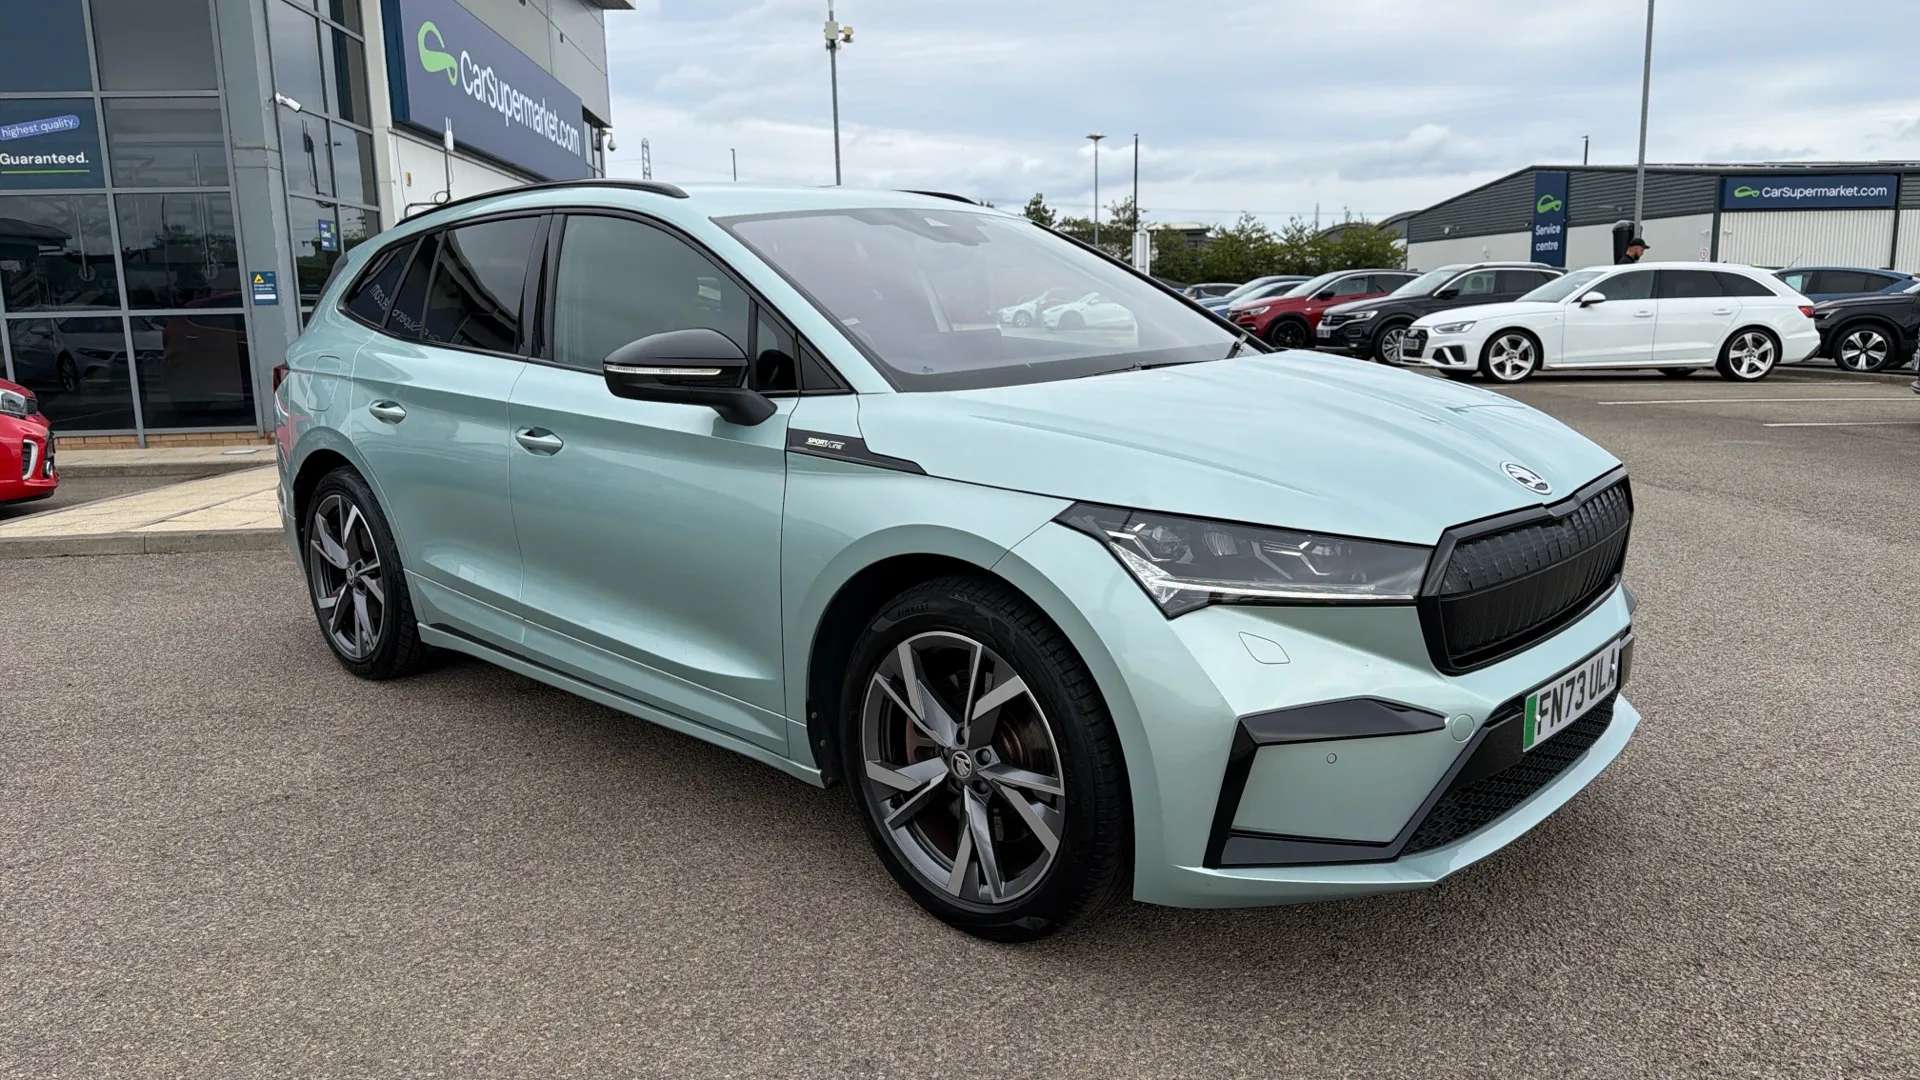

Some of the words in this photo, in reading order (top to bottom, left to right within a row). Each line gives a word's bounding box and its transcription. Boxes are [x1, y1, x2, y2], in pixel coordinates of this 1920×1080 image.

[460, 50, 581, 157] CarSupermarket.com
[1, 123, 40, 138] highest
[41, 118, 77, 132] quality.
[0, 152, 89, 165] Guaranteed.
[1761, 185, 1888, 200] CarSupermarket.com
[1535, 223, 1561, 236] Service
[1535, 240, 1559, 251] centre
[1537, 670, 1587, 736] FN73
[1589, 648, 1616, 701] ULA
